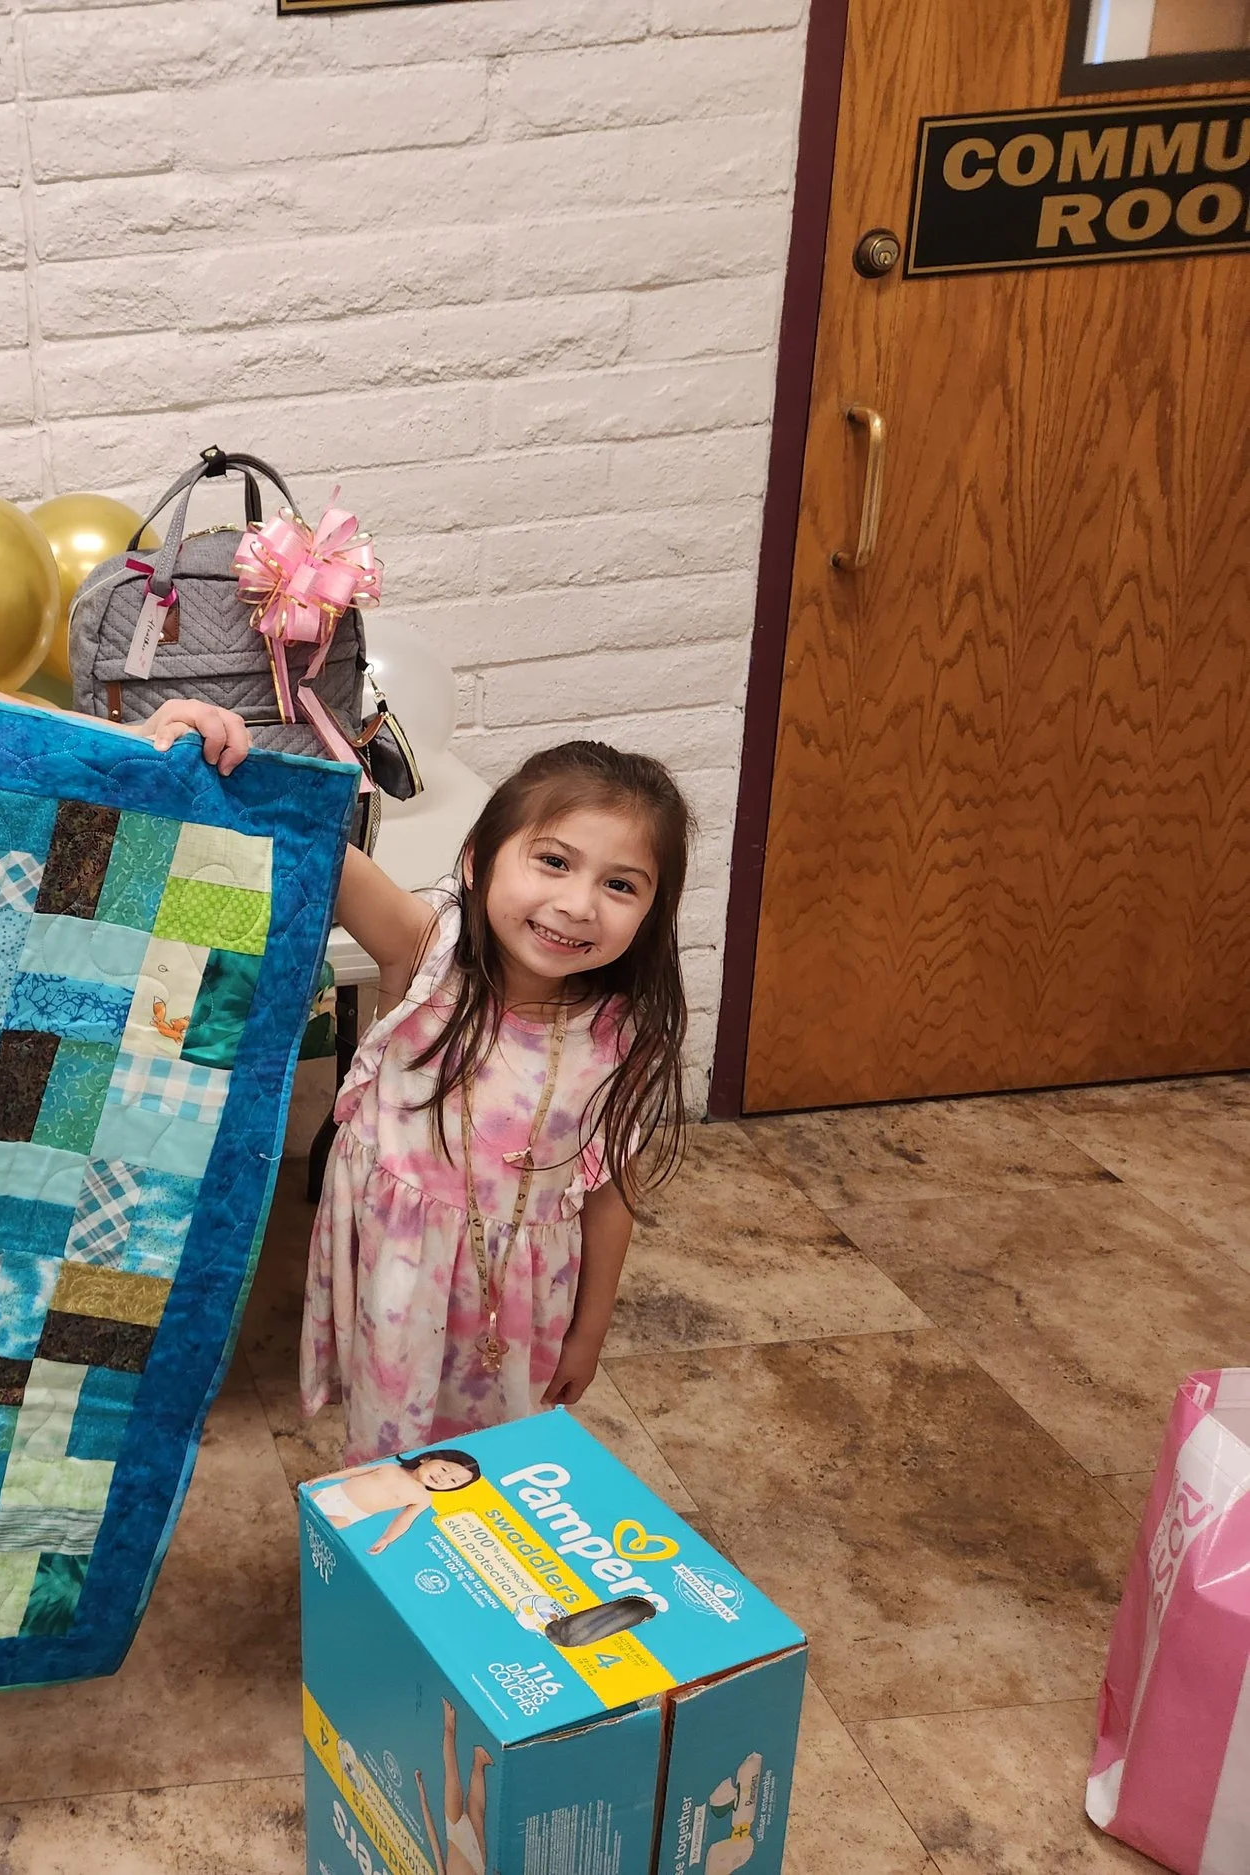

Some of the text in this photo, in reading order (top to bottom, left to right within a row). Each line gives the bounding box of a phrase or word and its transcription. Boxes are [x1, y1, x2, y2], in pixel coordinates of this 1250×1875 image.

[1036, 181, 1250, 248] ROO
[431, 1535, 467, 1575] protection
[443, 1558, 460, 1574] 100
[445, 1520, 518, 1599] skin protection
[485, 1509, 580, 1604] swaddlers
[494, 1553, 534, 1593] LEAKPROOF
[464, 1569, 477, 1583] de
[472, 1578, 484, 1592] la
[678, 1567, 733, 1619] PEDIATRICIAN
[477, 1590, 500, 1610] peau
[527, 1662, 564, 1696] 116
[594, 1652, 623, 1670] 4
[488, 1662, 540, 1717] COUCHES
[505, 1662, 550, 1706] DIAPERS
[675, 1796, 692, 1859] together
